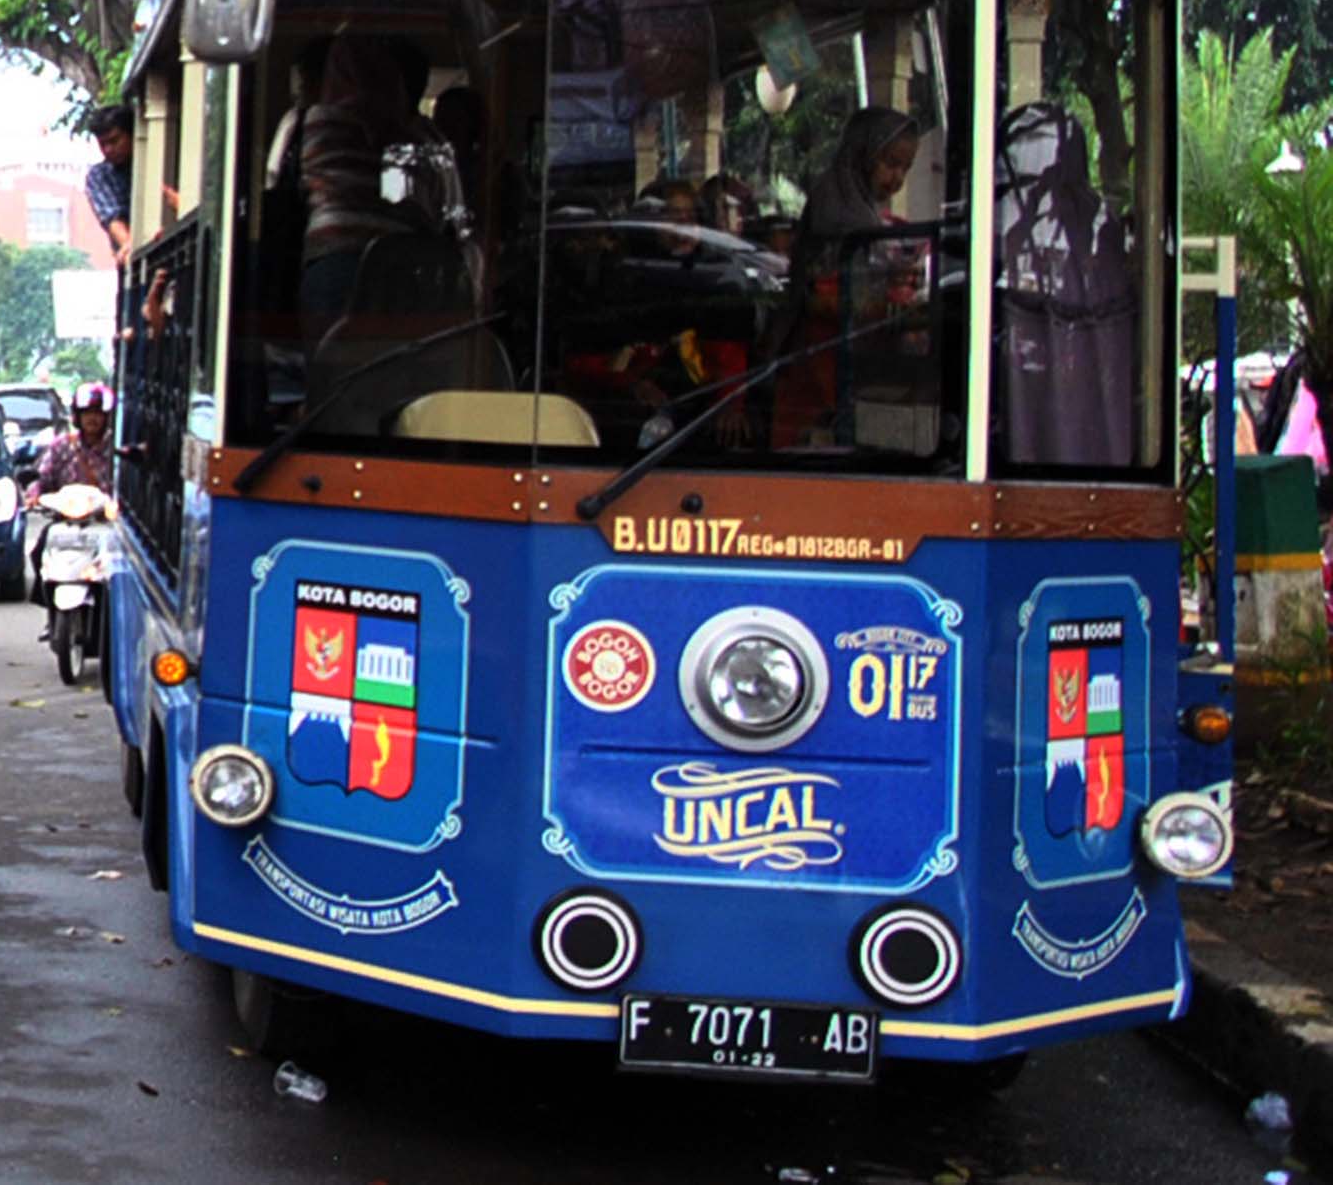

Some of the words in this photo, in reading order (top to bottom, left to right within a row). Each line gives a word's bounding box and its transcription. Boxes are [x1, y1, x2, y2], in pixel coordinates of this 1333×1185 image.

[297, 584, 346, 606] KOTA
[350, 590, 417, 614] BOGOR
[1049, 623, 1080, 642] KOTA
[1082, 620, 1123, 641] BOGOR
[579, 669, 641, 701] BOGOR
[906, 700, 937, 721] BUS
[662, 784, 833, 844] UNCAL
[254, 850, 328, 916] TRANSPORTASI
[328, 903, 370, 927] WISATA
[629, 1000, 651, 1042] F
[687, 1003, 772, 1050] 7071
[822, 1011, 869, 1054] AB
